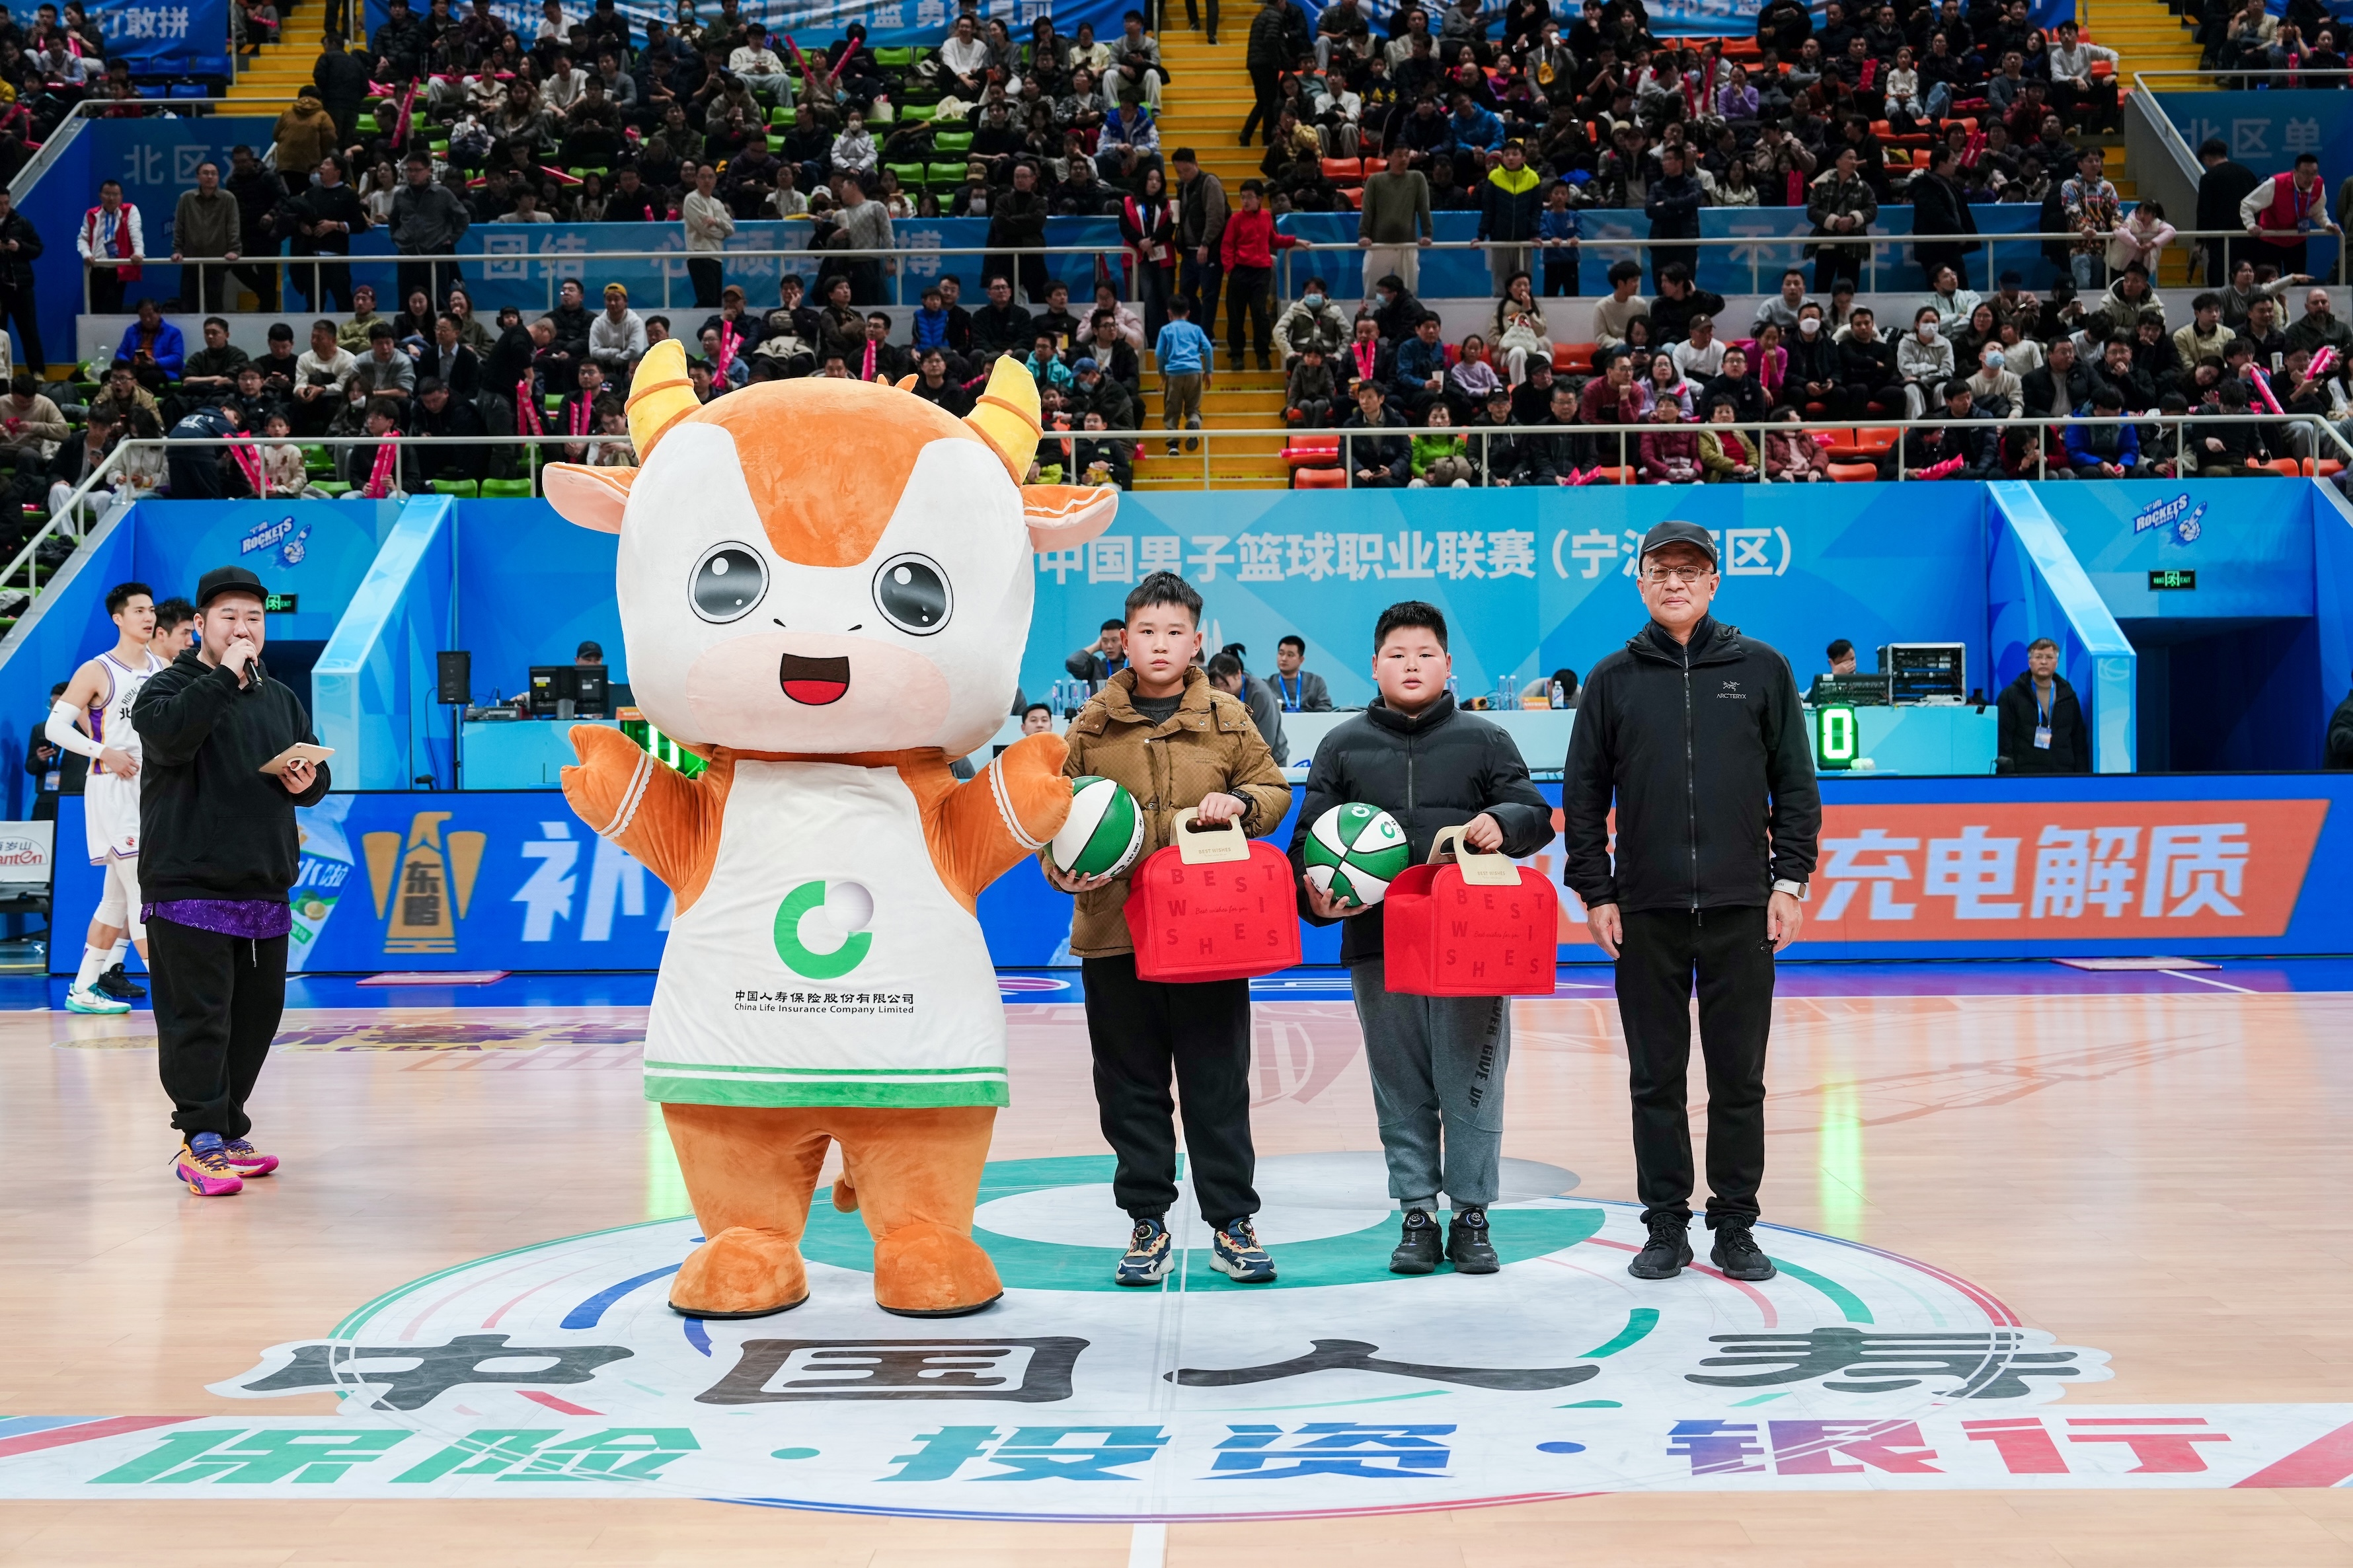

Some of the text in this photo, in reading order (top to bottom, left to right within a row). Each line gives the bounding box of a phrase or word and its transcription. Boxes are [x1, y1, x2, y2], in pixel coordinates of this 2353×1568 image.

[2136, 494, 2188, 532] ROCKETS
[242, 517, 292, 553] ROCKETS
[735, 990, 914, 1004] 中国人寿保险股份有限公司
[779, 1004, 827, 1013] Insurance
[829, 1006, 875, 1014] Company
[1475, 1044, 1493, 1081] GIVE
[1468, 1086, 1483, 1109] UP
[240, 1327, 2081, 1411] 中国人寿
